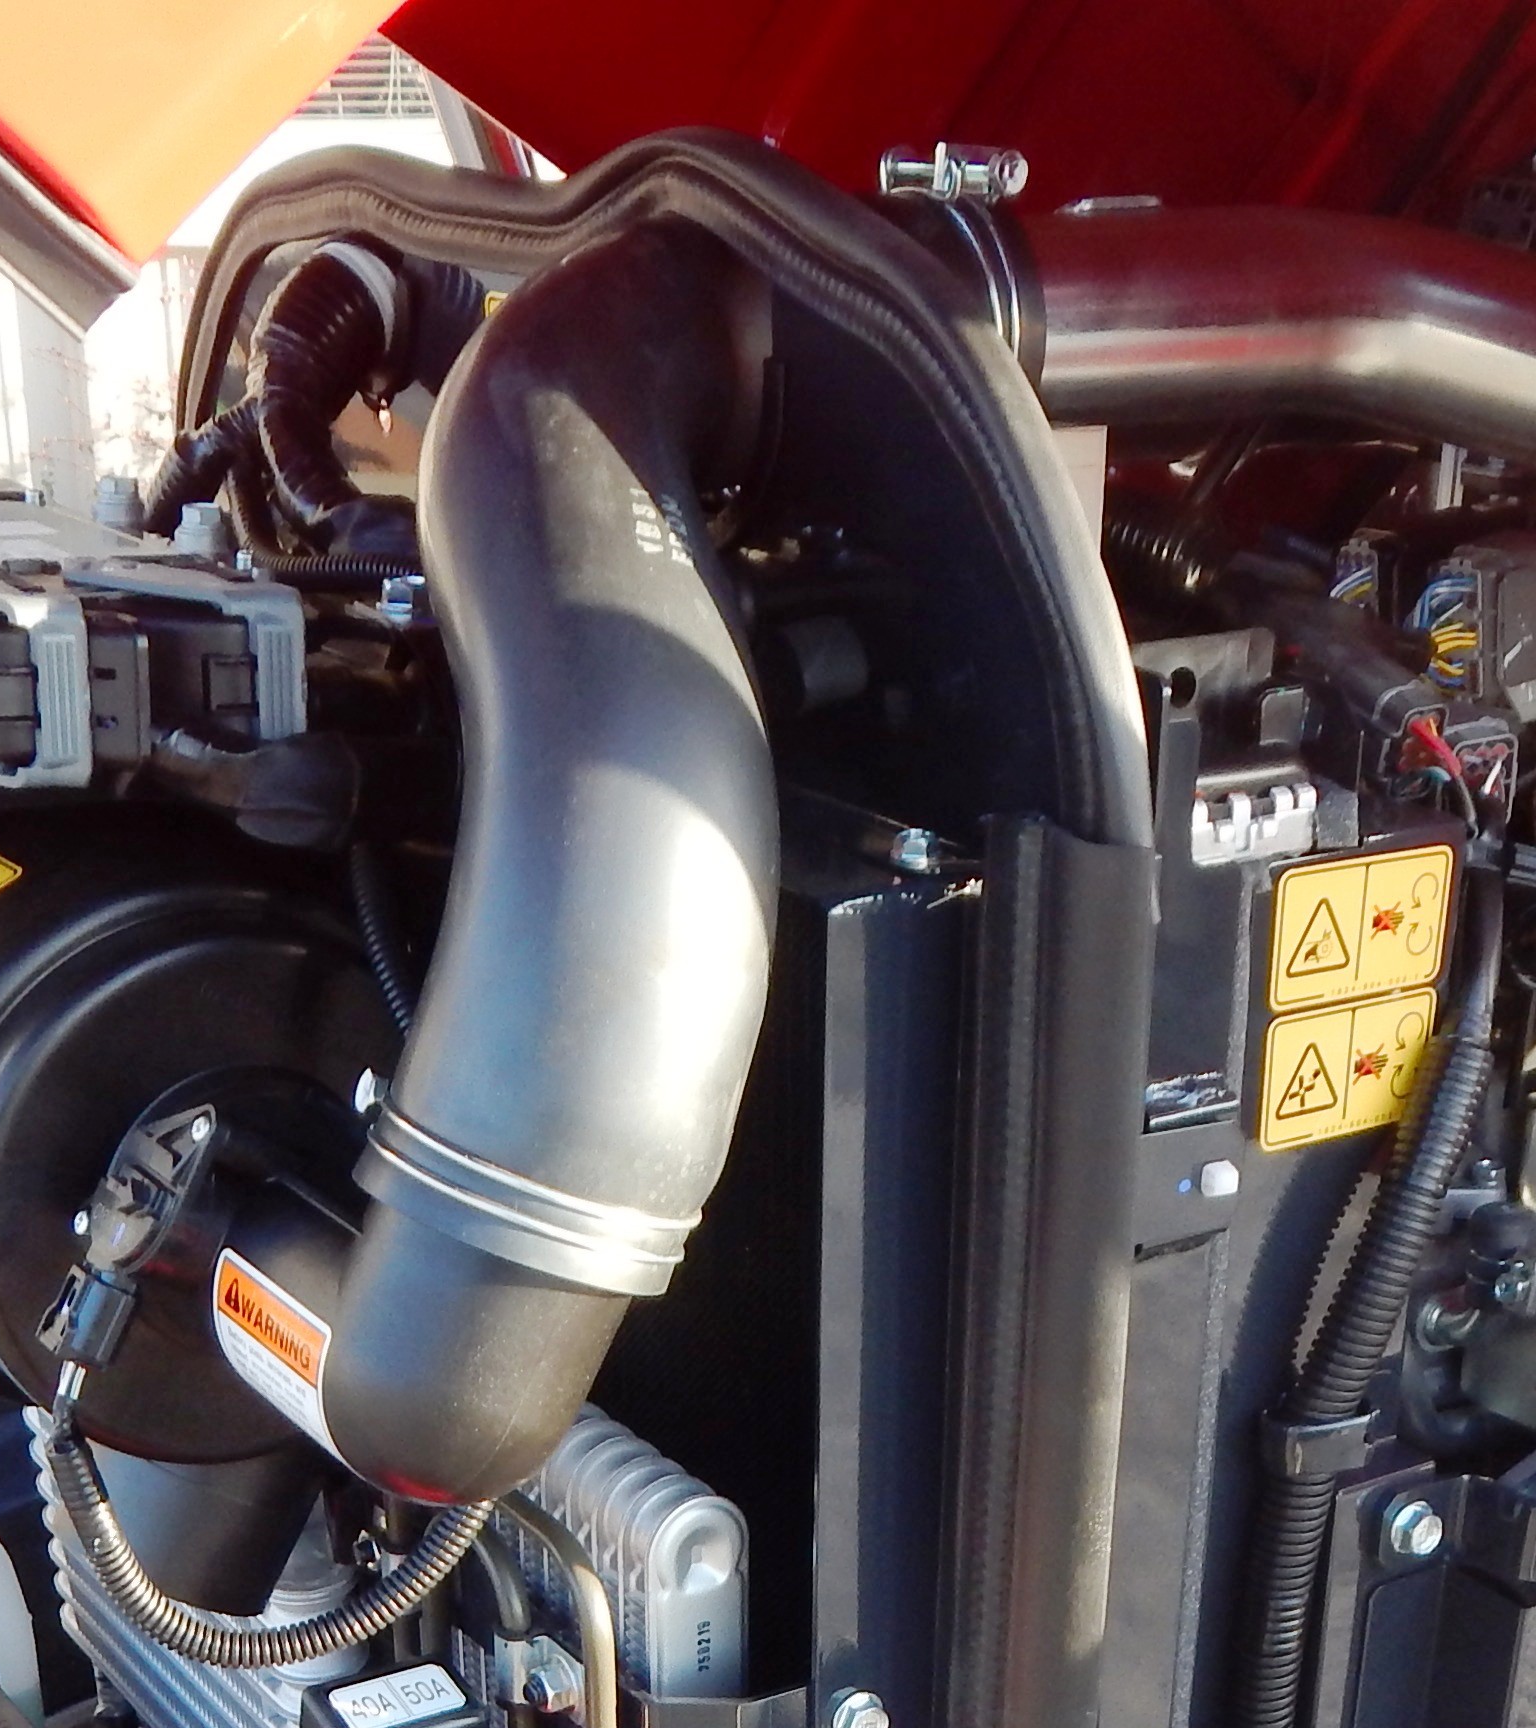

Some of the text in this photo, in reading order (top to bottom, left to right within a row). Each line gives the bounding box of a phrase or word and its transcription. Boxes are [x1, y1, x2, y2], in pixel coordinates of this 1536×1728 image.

[241, 1294, 311, 1370] WARNING
[351, 1678, 450, 1718] 40A 50A
